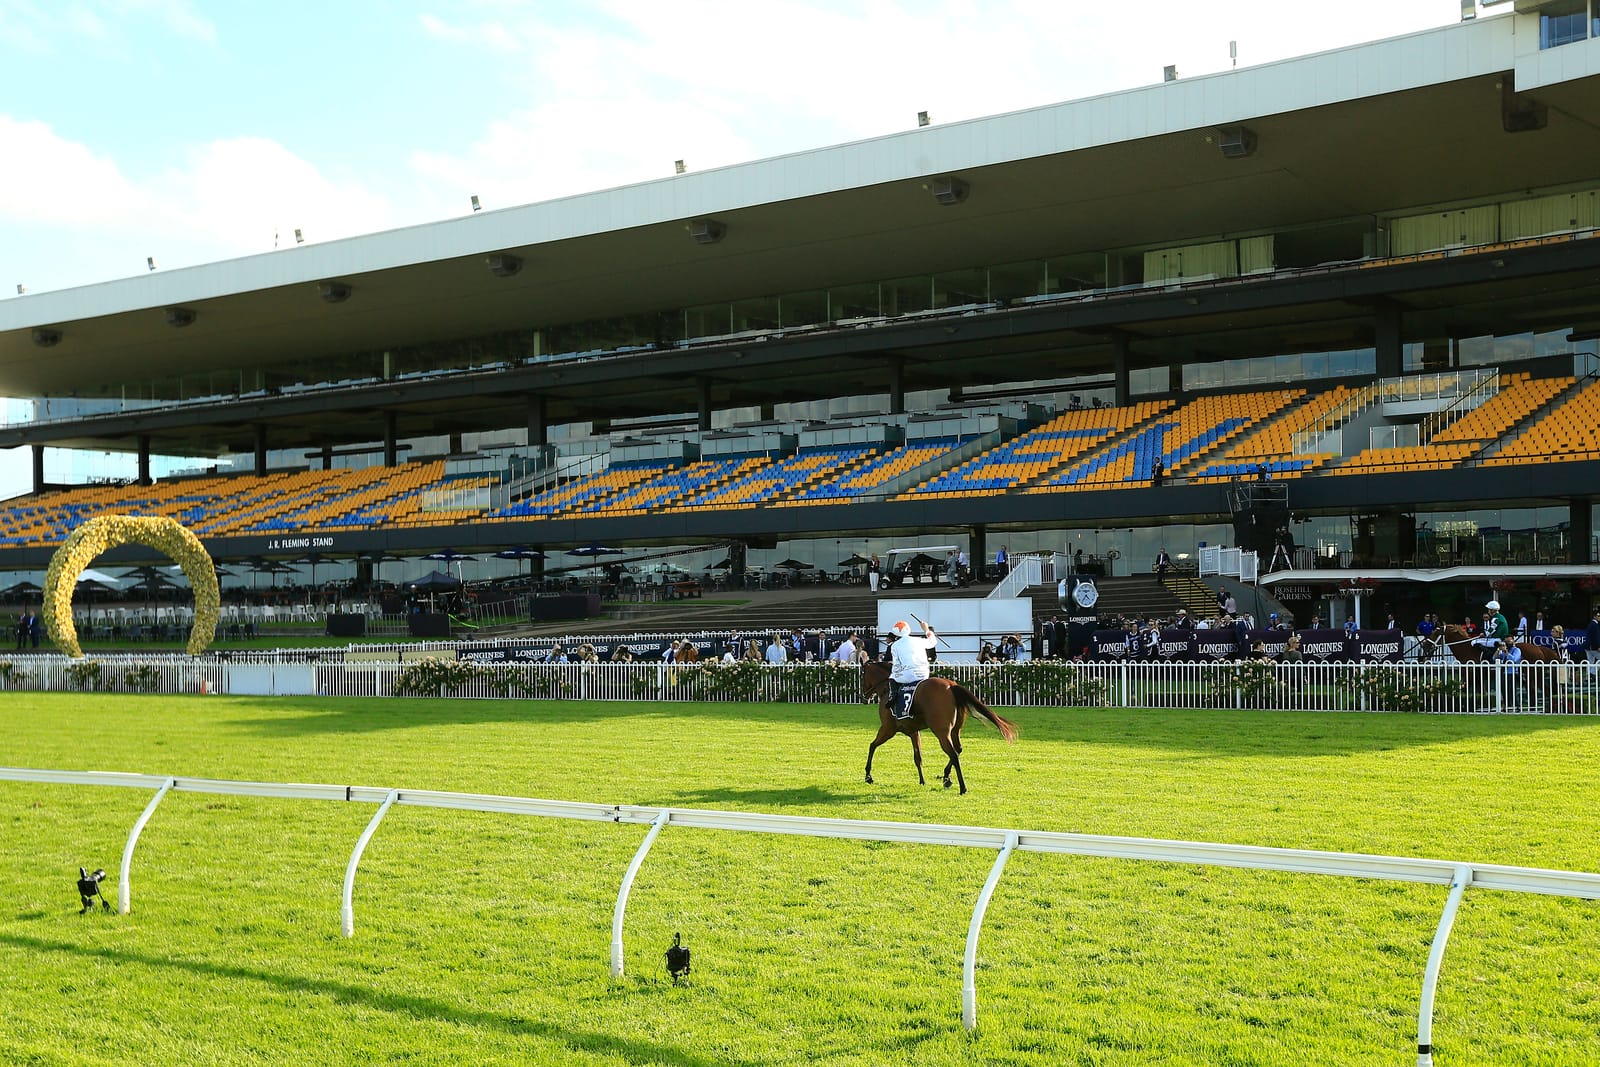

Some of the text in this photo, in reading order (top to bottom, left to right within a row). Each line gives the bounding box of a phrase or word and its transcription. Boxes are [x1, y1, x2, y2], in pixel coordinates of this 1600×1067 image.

[268, 536, 334, 549] J. R. FLEMING STAND
[1302, 641, 1344, 654] LONGINES
[1360, 642, 1400, 655] LONGINES
